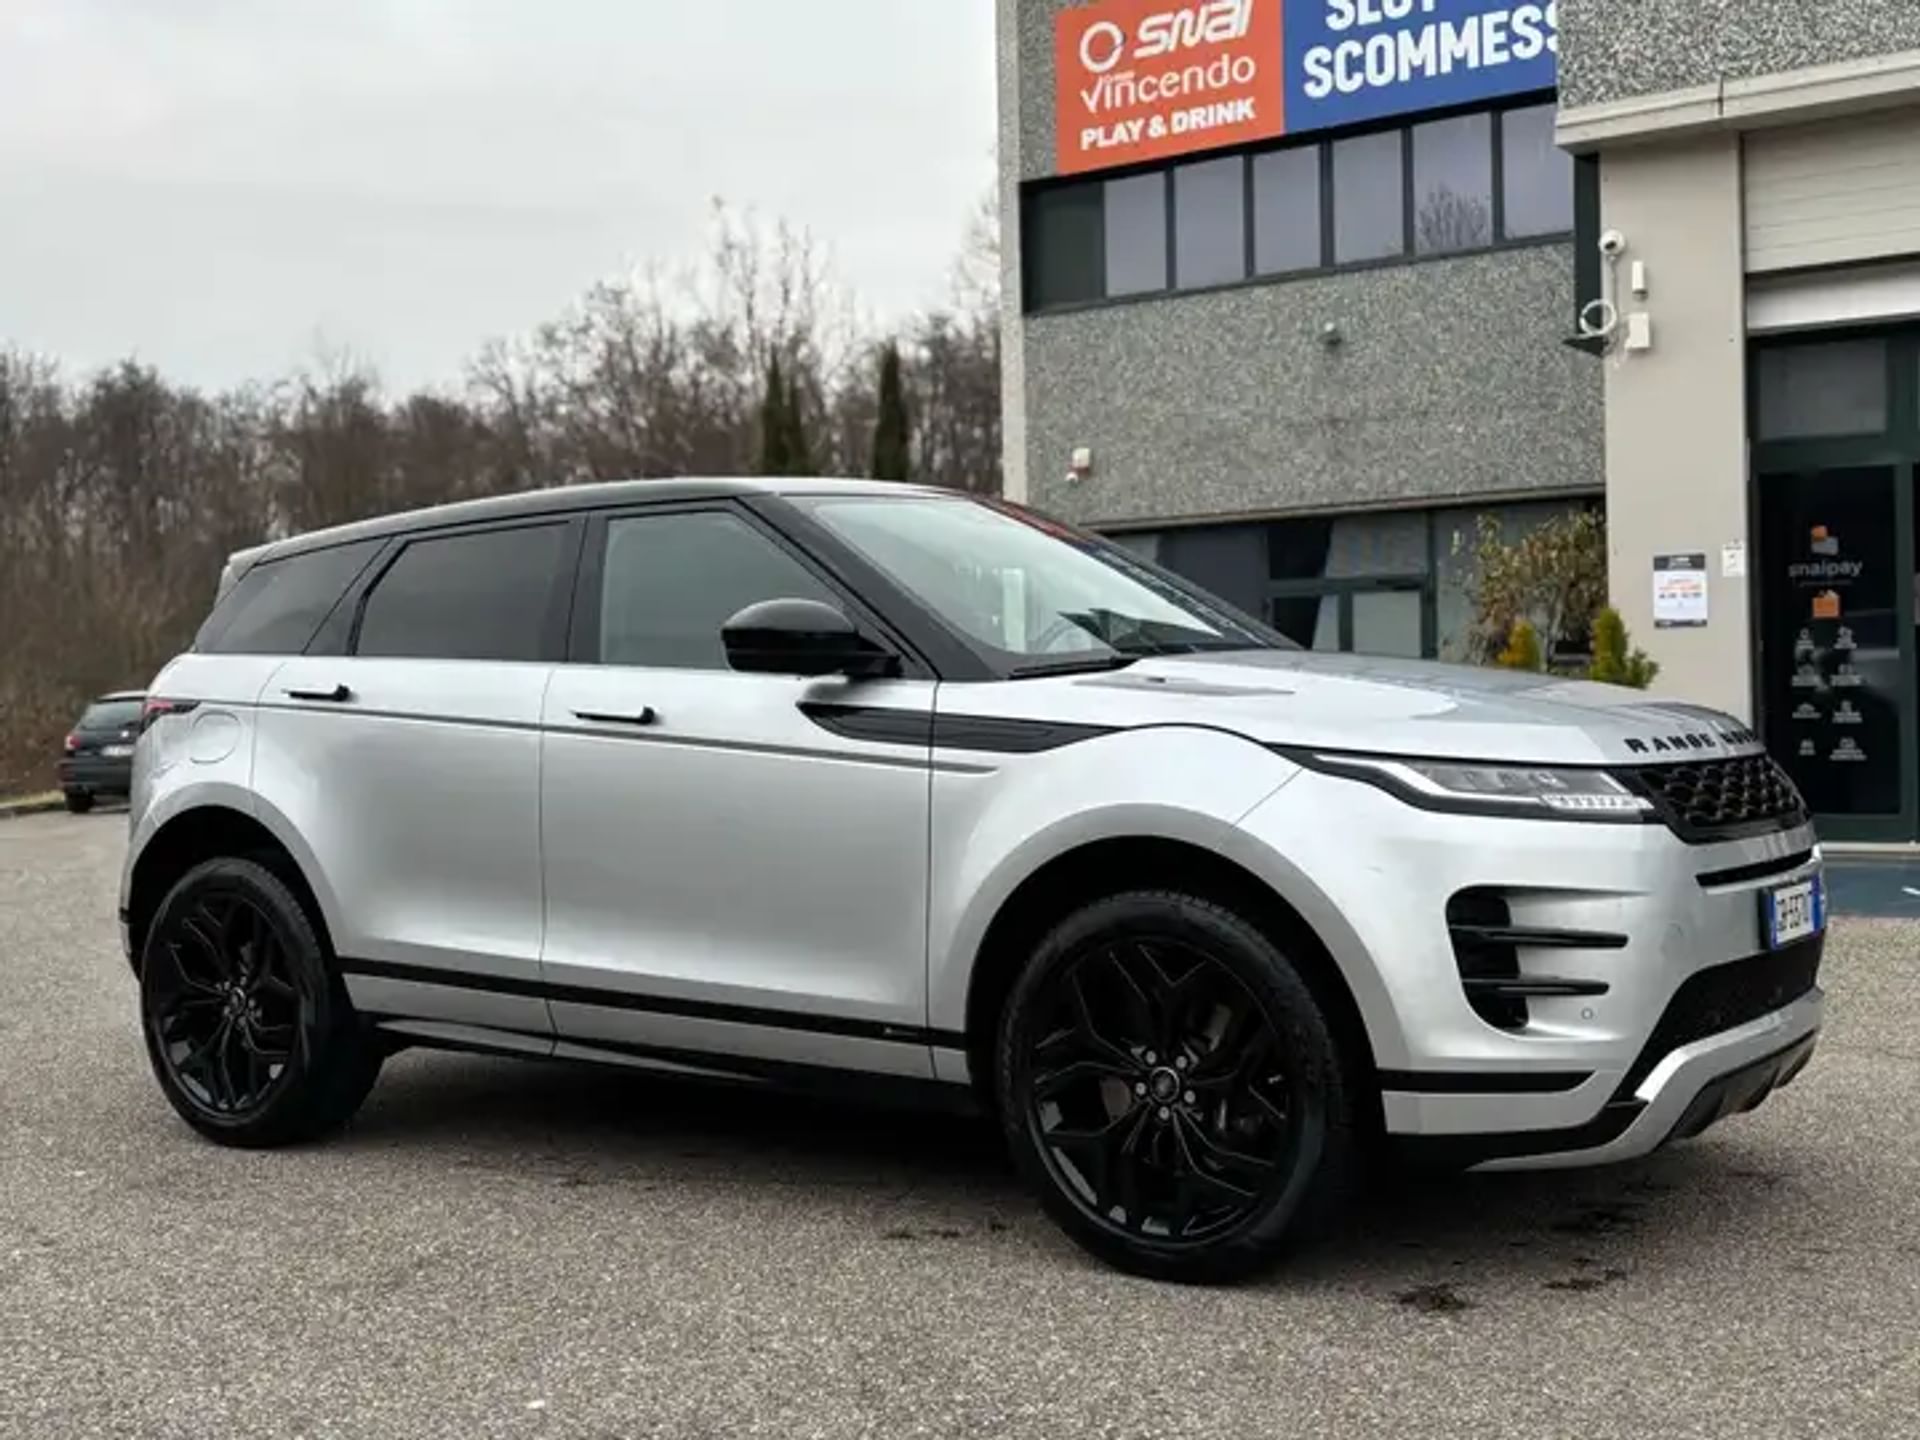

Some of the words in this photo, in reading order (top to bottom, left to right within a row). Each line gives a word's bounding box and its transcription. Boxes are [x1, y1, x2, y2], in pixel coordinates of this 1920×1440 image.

[1080, 118, 1145, 150] PLAY
[1148, 115, 1167, 138] &
[1170, 97, 1256, 135] DRINK
[1624, 733, 1716, 753] RANGE
